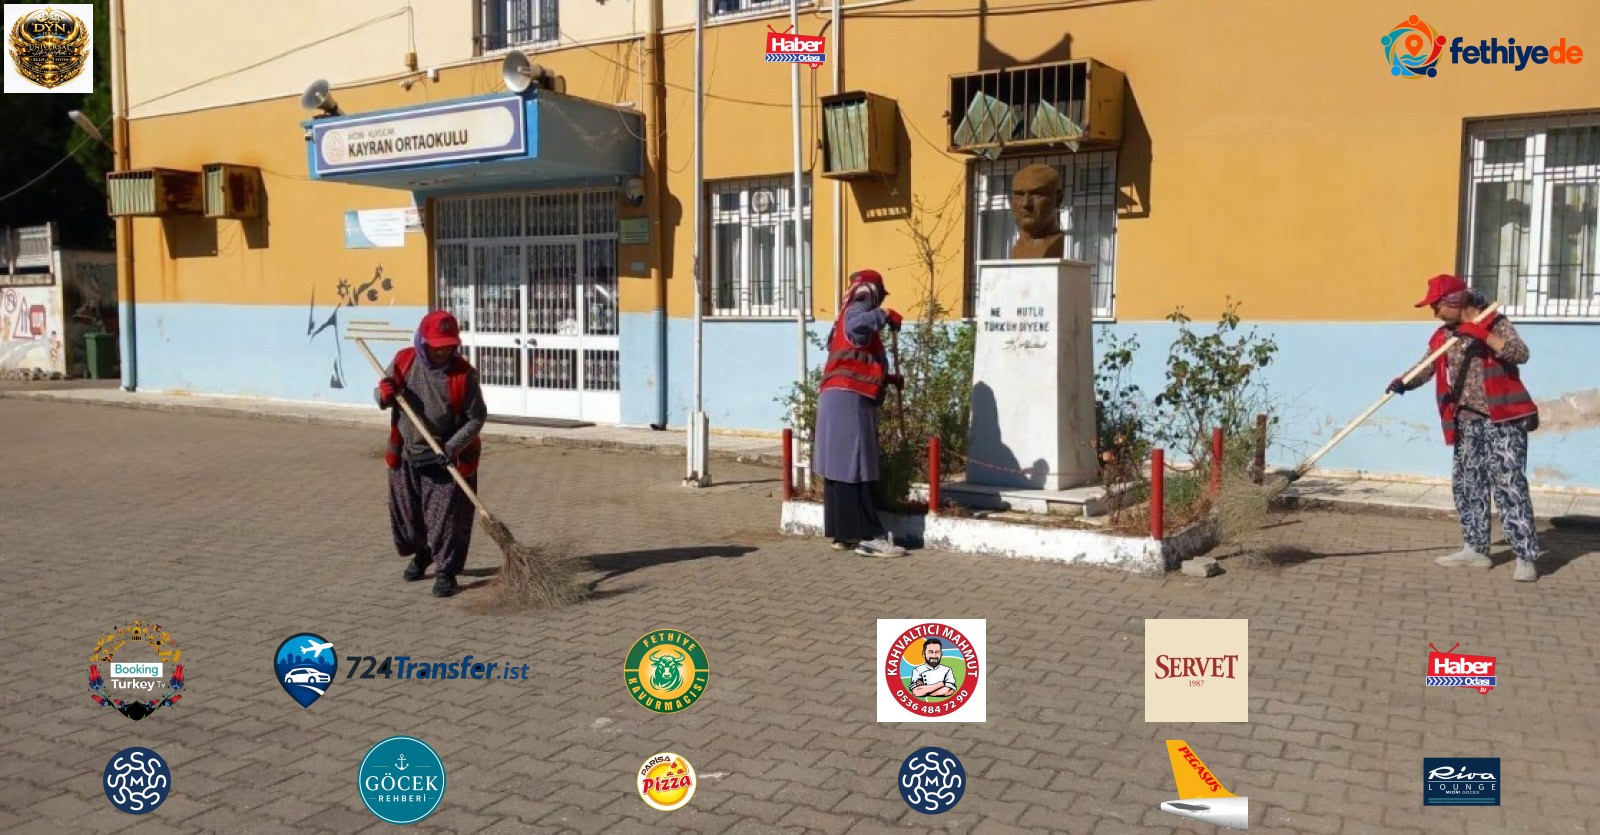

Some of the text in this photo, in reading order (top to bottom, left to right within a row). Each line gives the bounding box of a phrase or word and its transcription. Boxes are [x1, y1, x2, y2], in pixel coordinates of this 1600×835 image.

[348, 129, 468, 158] KAYRAN ORTAOKULU
[990, 307, 1002, 317] NE
